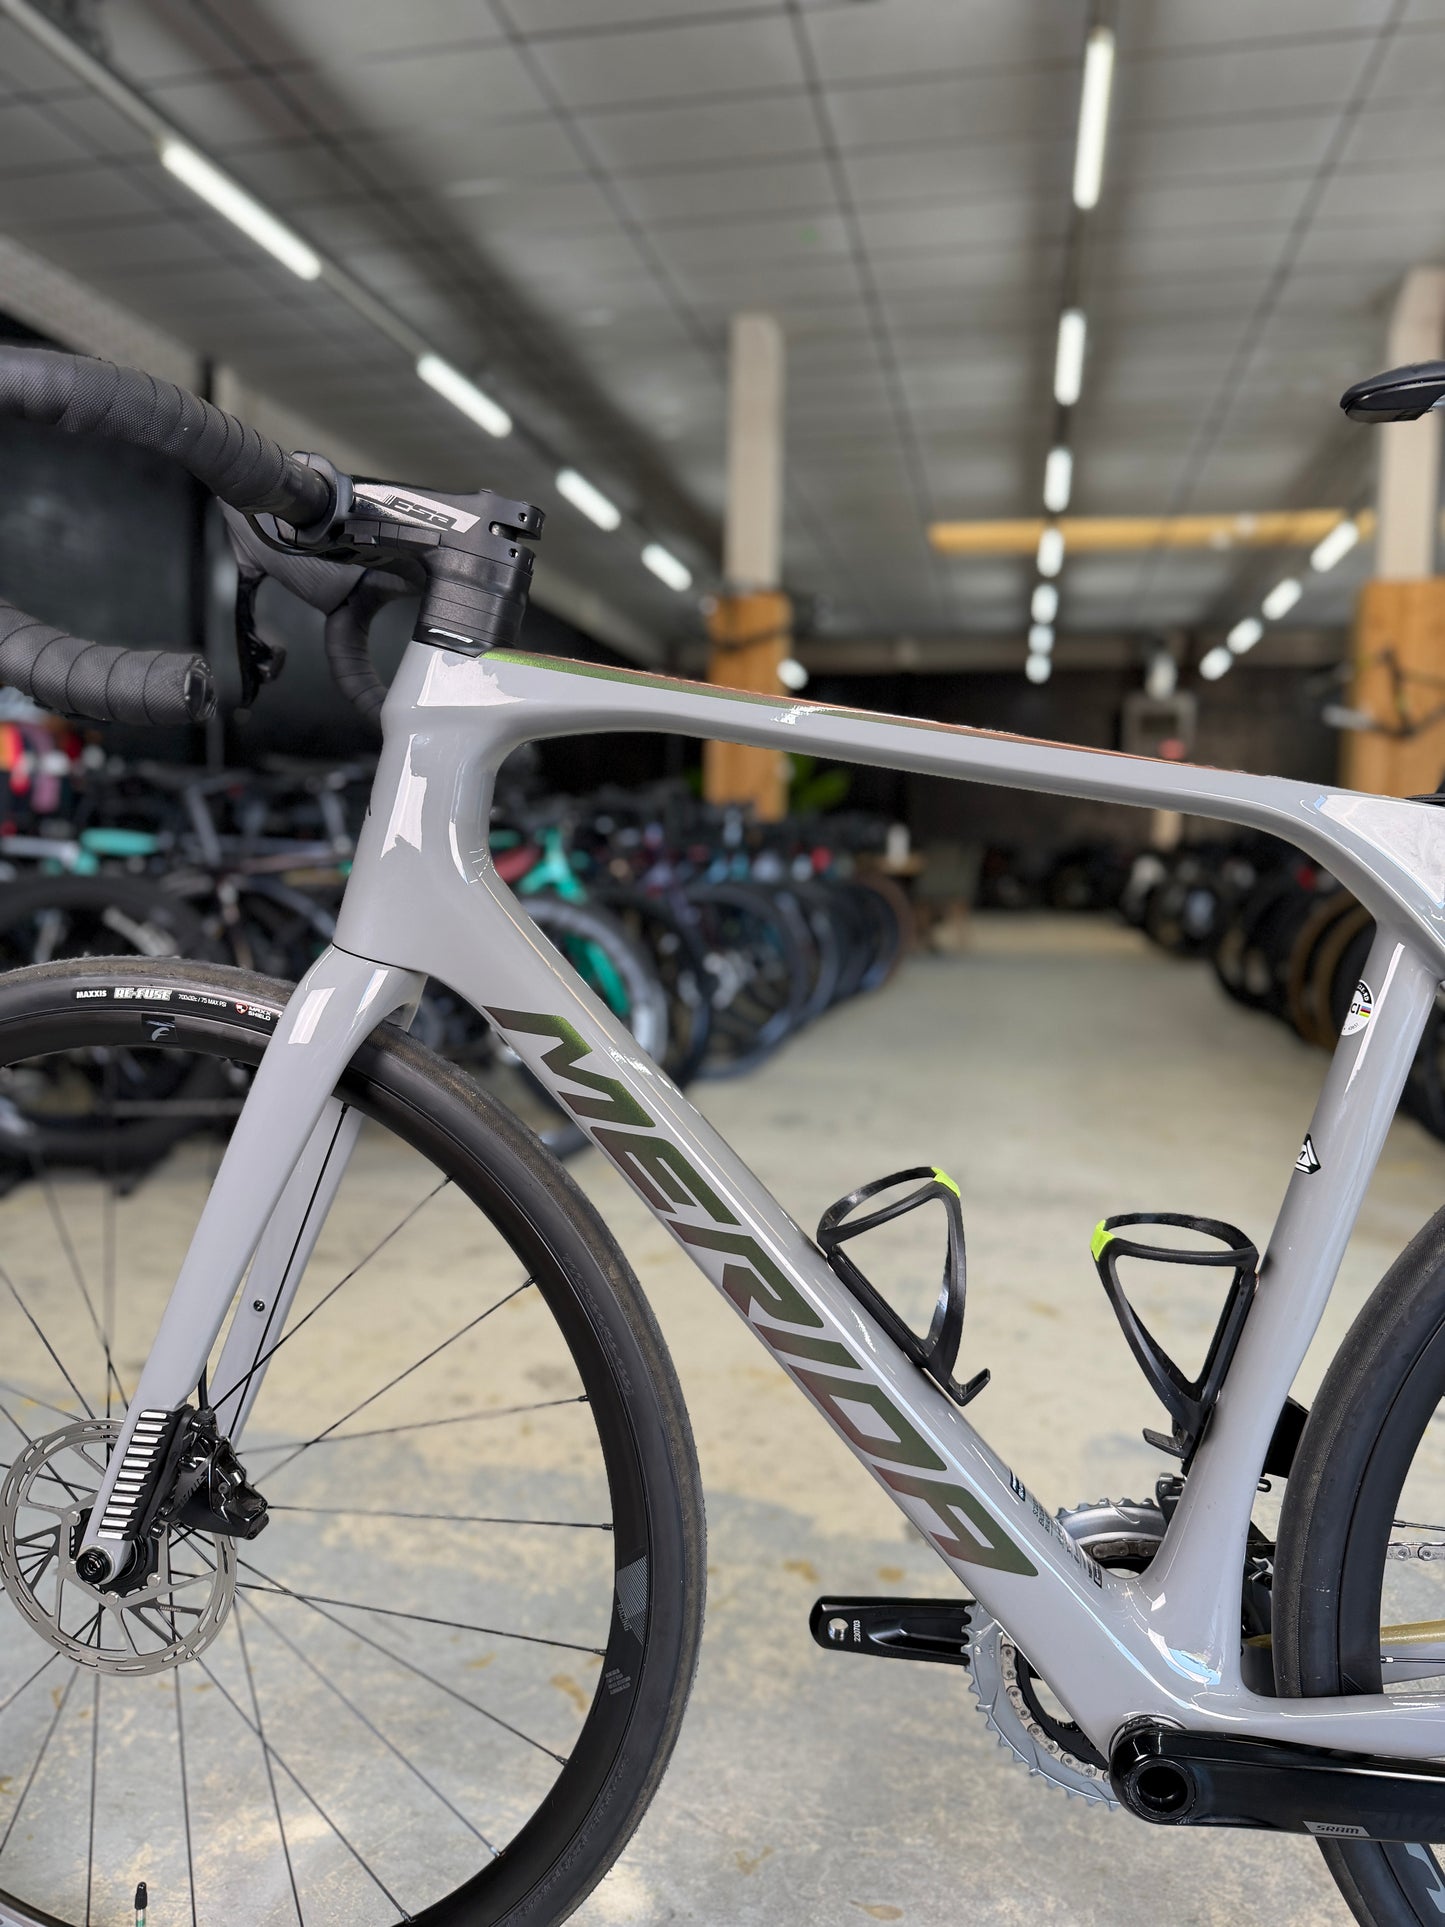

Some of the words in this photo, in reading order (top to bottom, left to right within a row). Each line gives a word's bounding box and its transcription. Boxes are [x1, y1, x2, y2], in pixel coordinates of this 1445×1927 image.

[76, 990, 107, 999] MAXXIS
[114, 987, 172, 1001] RE-FUSE
[208, 998, 219, 1006] MAX
[1349, 1002, 1360, 1015] CI
[248, 1011, 271, 1021] SHIELD
[483, 1006, 1038, 1577] MERIDA
[1316, 1825, 1360, 1834] SRAM
